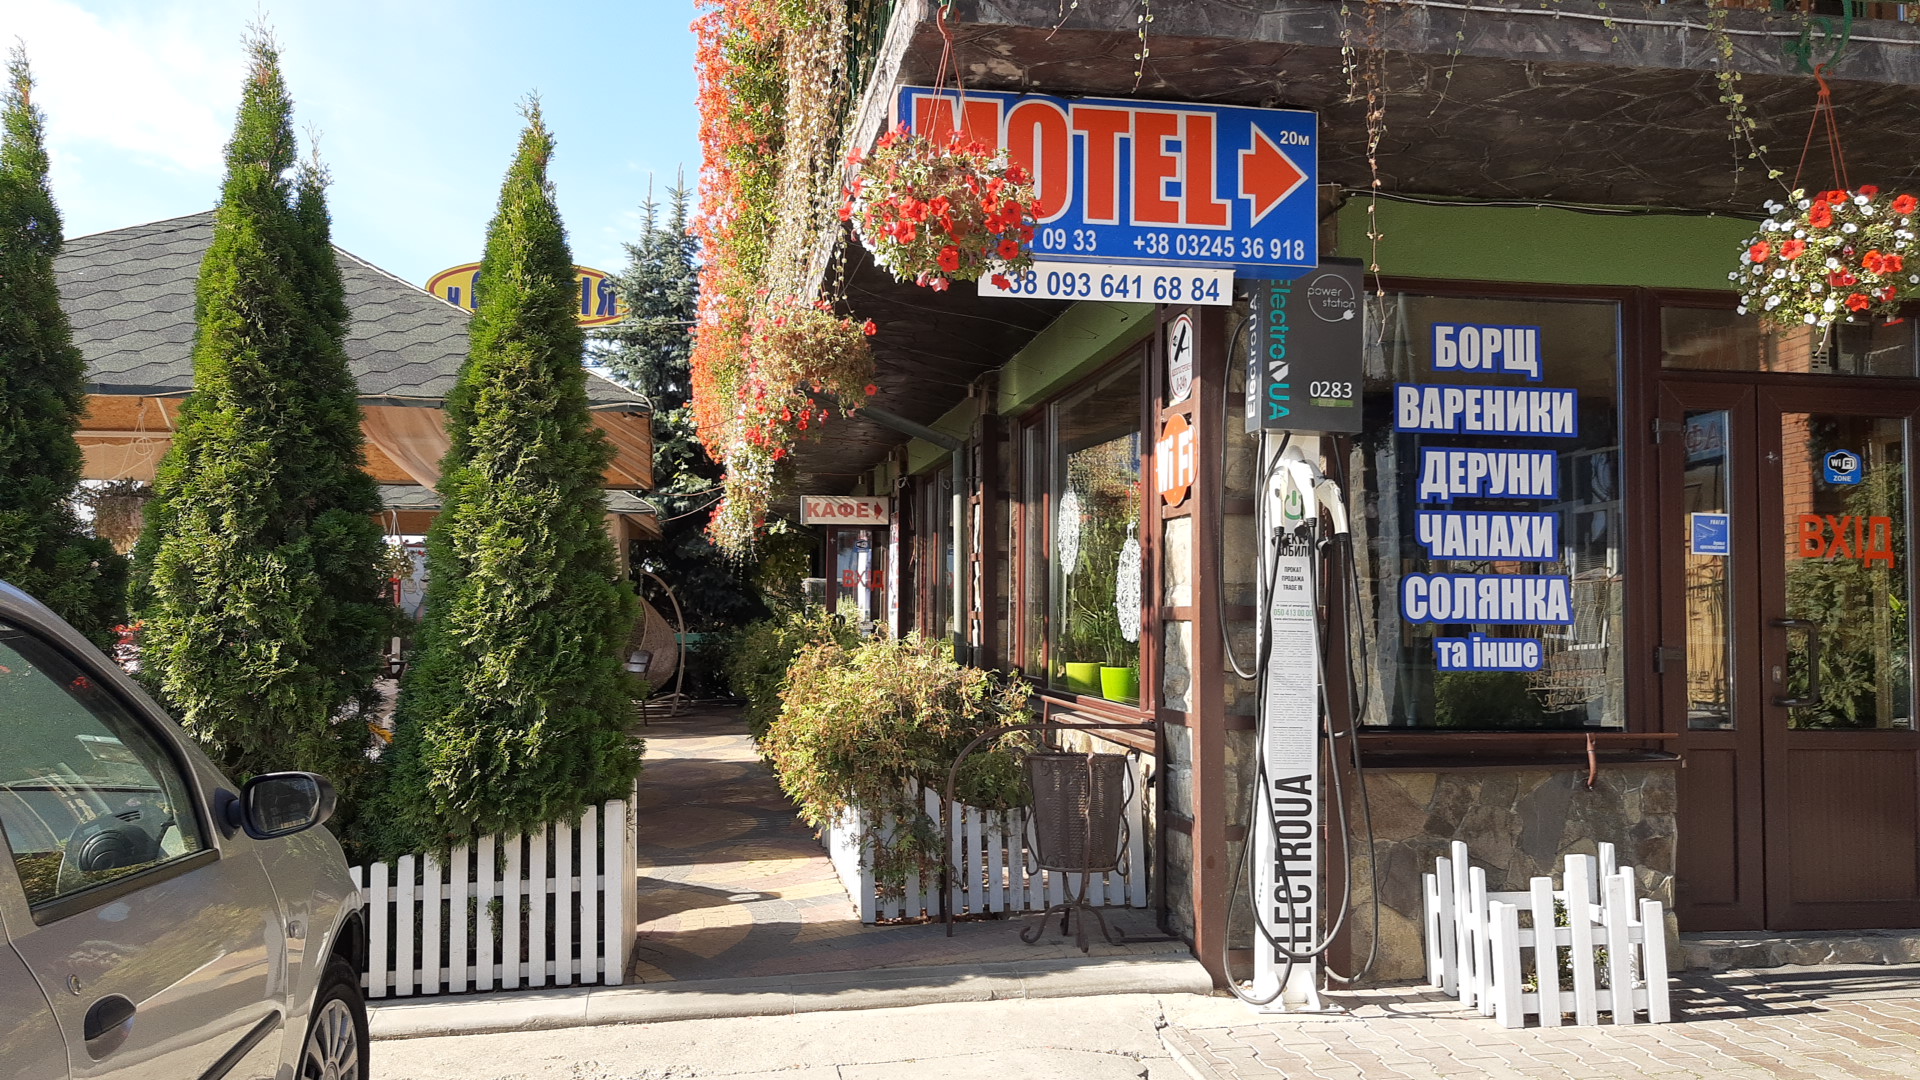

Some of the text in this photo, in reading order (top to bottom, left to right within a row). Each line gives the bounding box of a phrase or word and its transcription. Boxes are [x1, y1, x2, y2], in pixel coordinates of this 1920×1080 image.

[1042, 228, 1068, 252] 09
[1073, 229, 1098, 253] 33
[1133, 234, 1306, 261] +38 03245 36 918
[1047, 272, 1091, 297] 093
[1100, 274, 1142, 299] 641
[1153, 276, 1182, 300] 68
[1190, 277, 1220, 301] 84
[1307, 286, 1342, 298] power
[1322, 298, 1356, 309] station
[1435, 325, 1539, 378] БОРЩ
[1310, 381, 1353, 398] 0283
[1398, 387, 1573, 434] ВАРЕНИКИ
[1420, 452, 1553, 500] ДЕРУНИ
[806, 502, 869, 518] КАФЕ
[1419, 514, 1553, 558] ЧАНАХИ
[1798, 514, 1895, 569] ВХІД
[843, 569, 885, 591] ВХІД
[1273, 608, 1284, 616] 050
[1405, 576, 1569, 621] СОЛЯНКА
[1438, 637, 1538, 669] та інше
